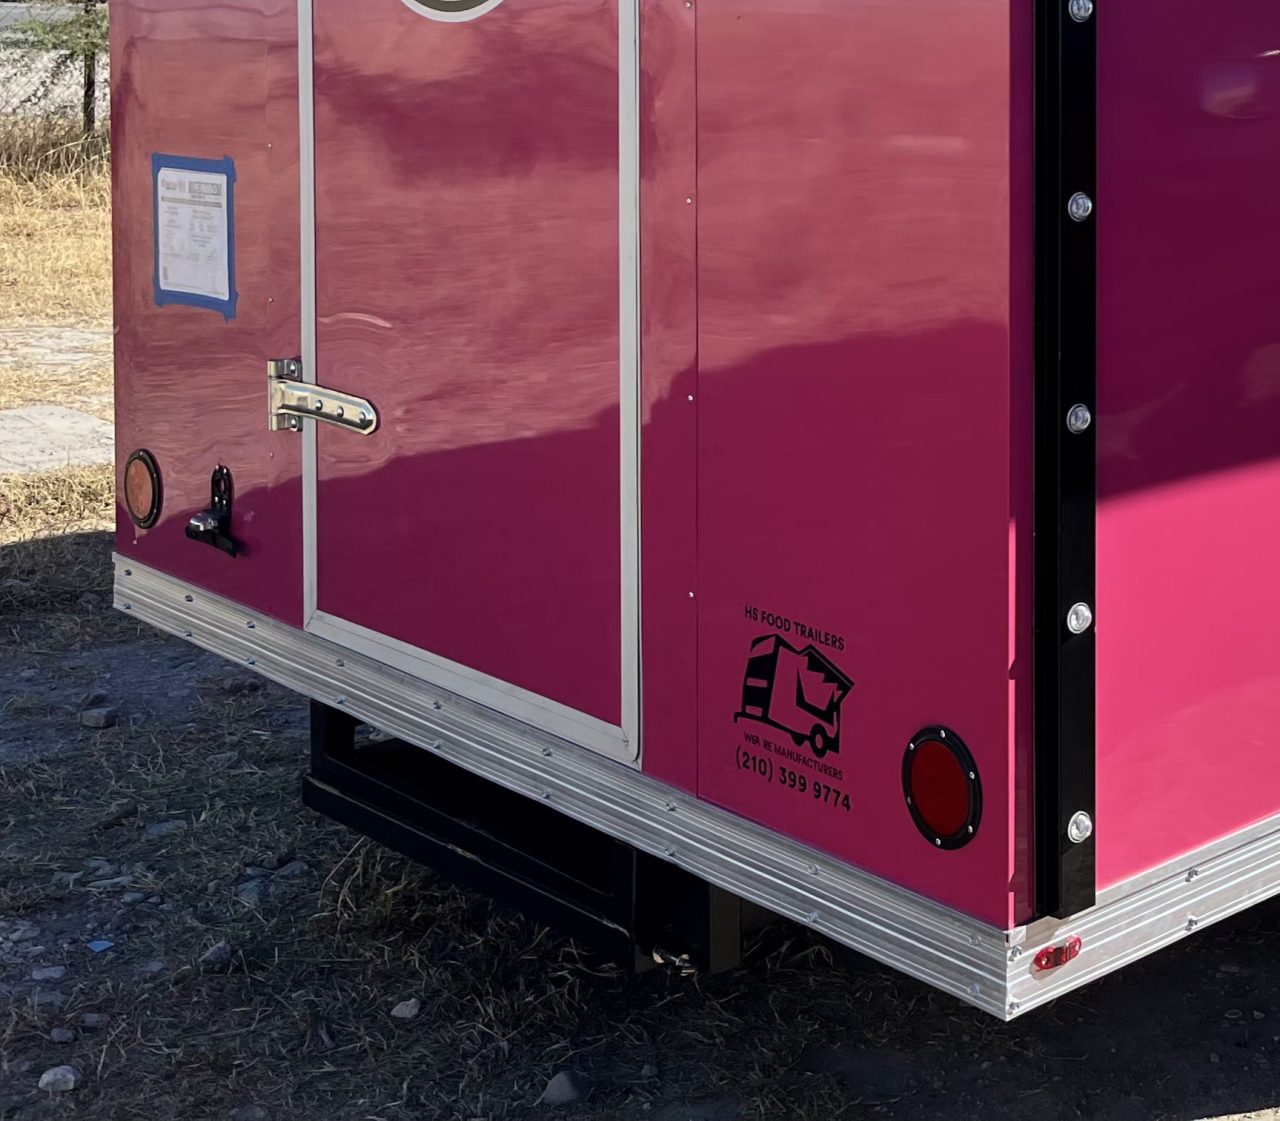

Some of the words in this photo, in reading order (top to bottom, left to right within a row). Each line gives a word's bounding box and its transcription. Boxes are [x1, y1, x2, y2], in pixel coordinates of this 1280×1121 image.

[744, 605, 759, 621] HS
[761, 611, 791, 632] FOOD
[793, 621, 845, 651] TRAILERS
[736, 746, 773, 783] (210)
[779, 766, 807, 793] 399
[813, 781, 852, 812] 9774
[774, 744, 843, 781] MANUFACTURERS
